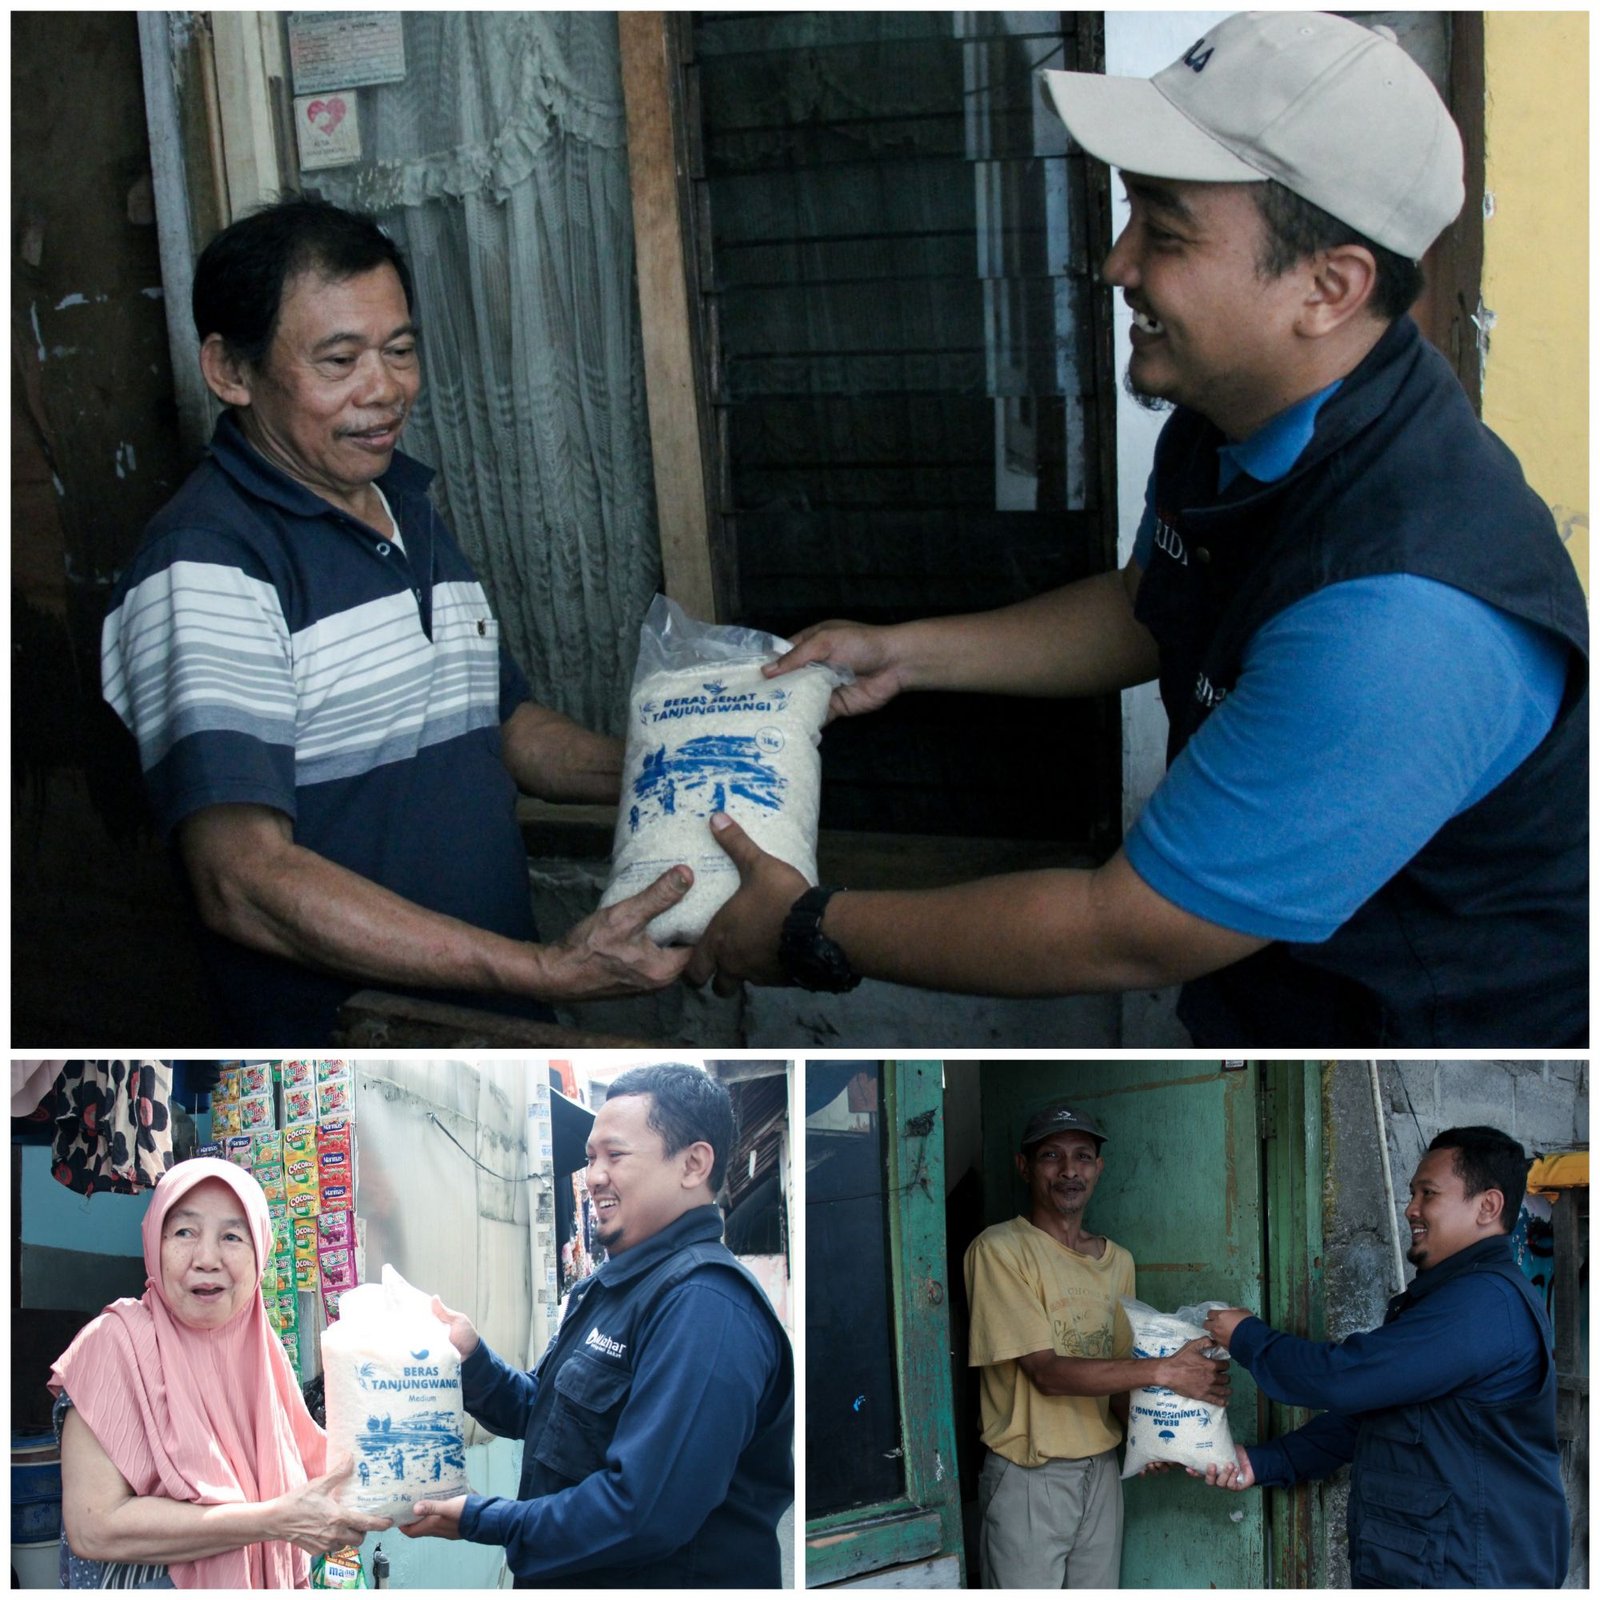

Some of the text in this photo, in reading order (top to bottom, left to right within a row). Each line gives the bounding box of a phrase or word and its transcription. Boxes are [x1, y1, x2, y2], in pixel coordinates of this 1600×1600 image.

[663, 693, 707, 708] BERAS
[652, 702, 771, 722] TANJUNGWANGI
[403, 1366, 439, 1377] BERAS
[371, 1379, 459, 1392] TANJUNGWANG
[408, 1395, 437, 1403] Medium
[1135, 1406, 1201, 1420] TANJUNGWANGI
[1152, 1418, 1180, 1427] BERAS
